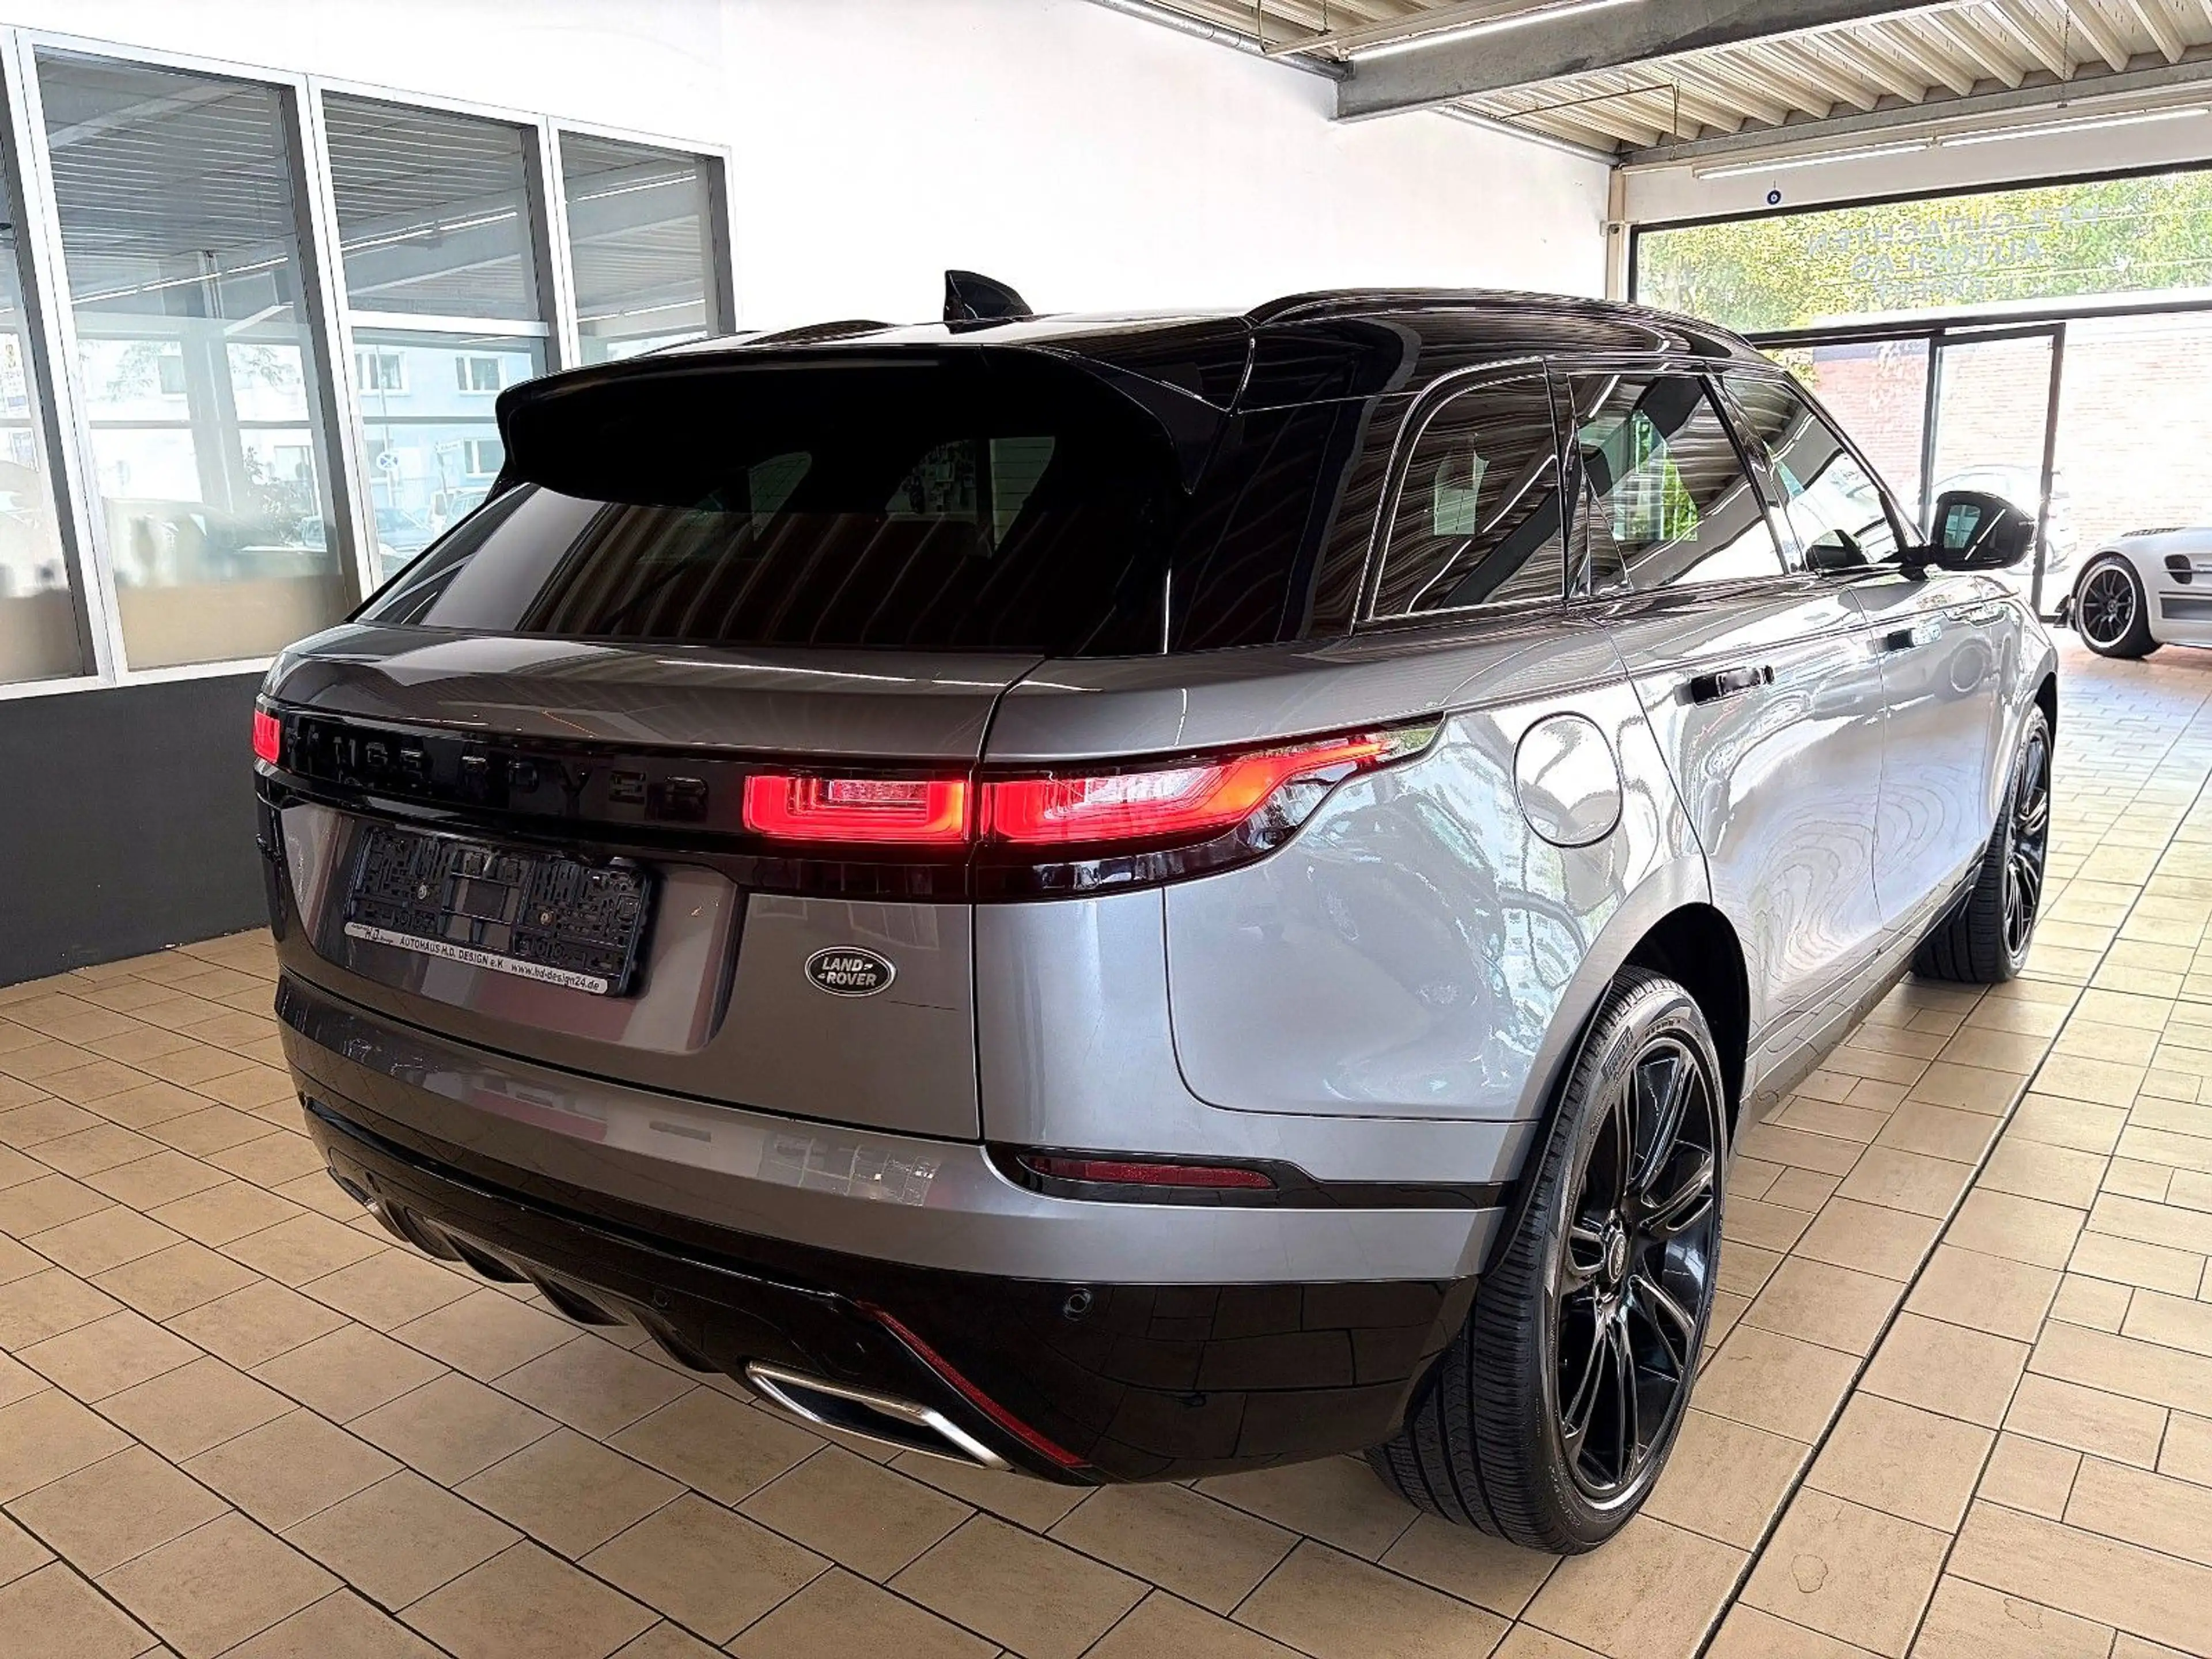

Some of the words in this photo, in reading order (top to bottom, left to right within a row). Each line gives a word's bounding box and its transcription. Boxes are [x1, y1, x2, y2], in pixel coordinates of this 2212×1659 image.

[399, 938, 440, 954] AUTOHAUS
[459, 950, 488, 965] DESIGN
[822, 957, 863, 972] LAND
[826, 972, 877, 986] ROVER
